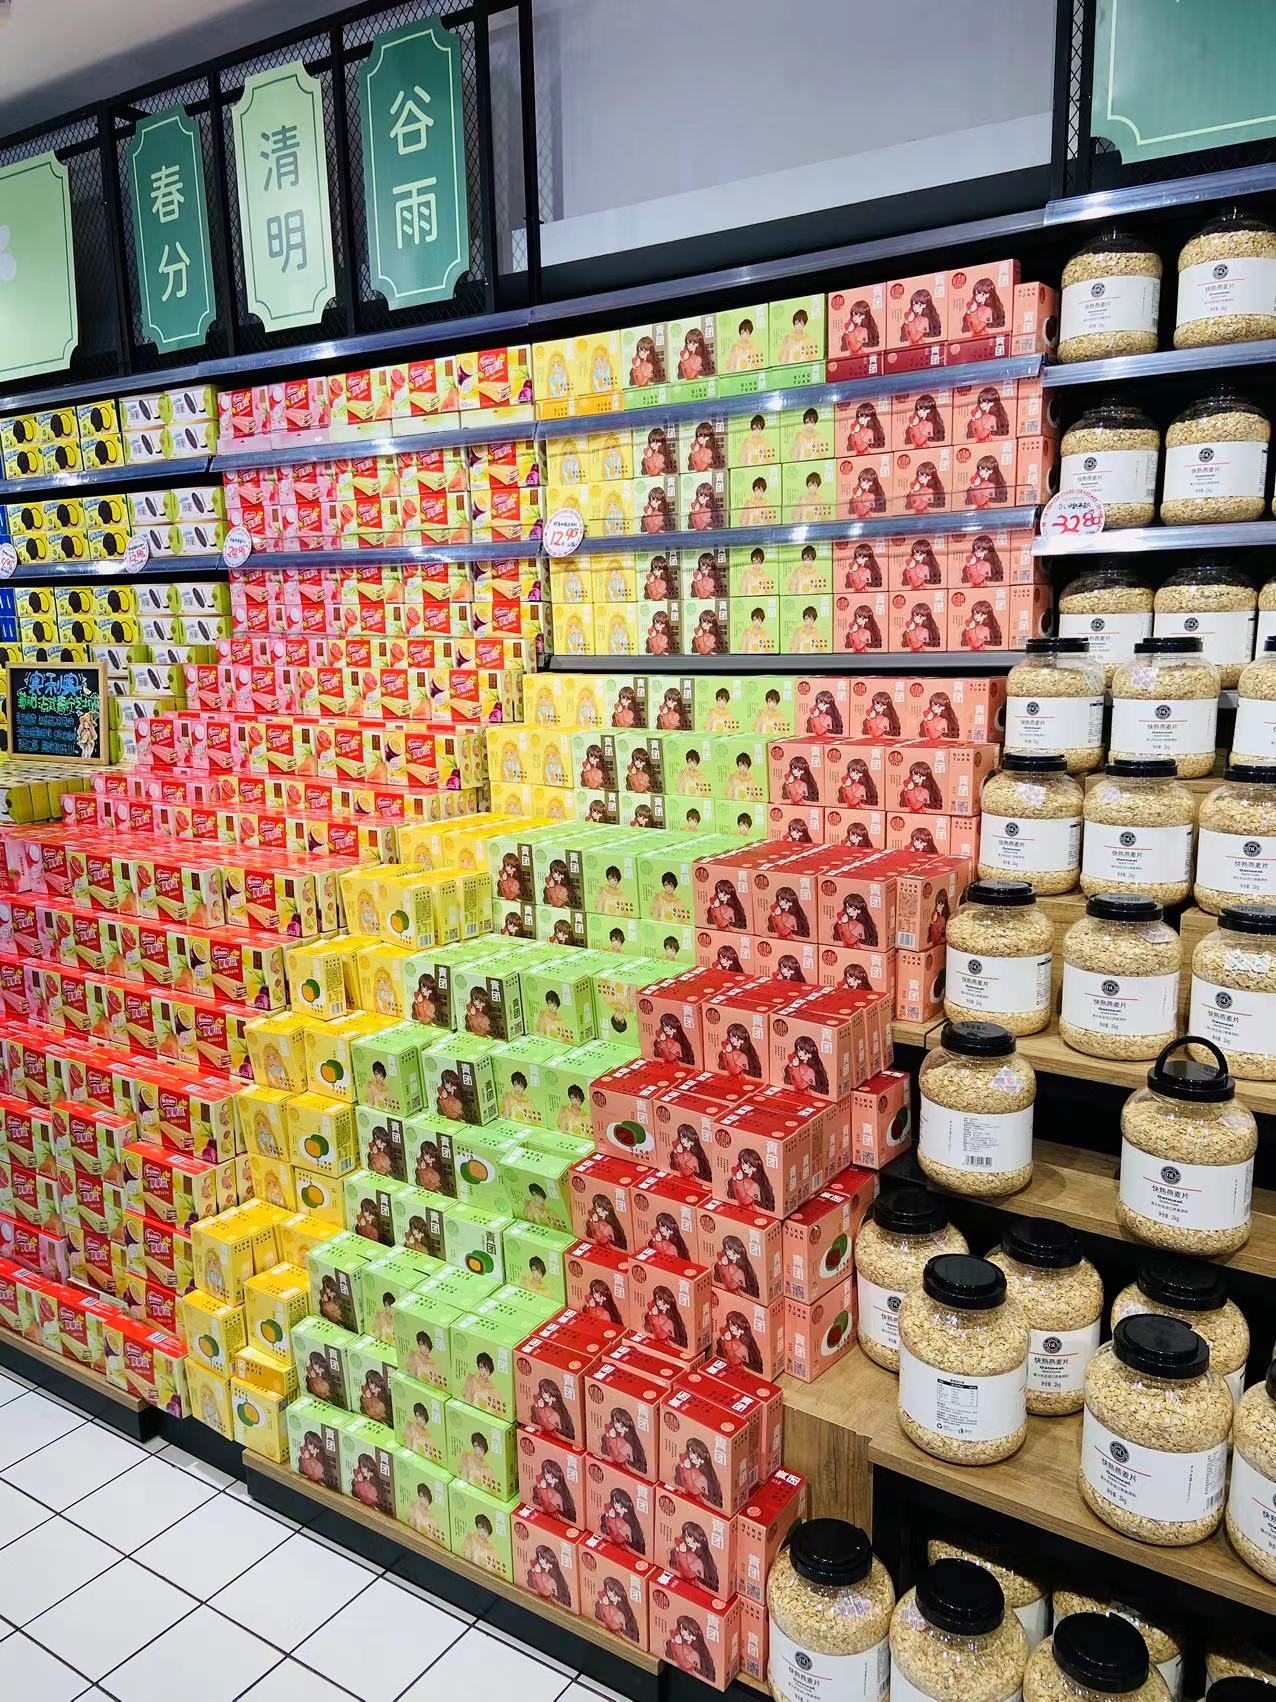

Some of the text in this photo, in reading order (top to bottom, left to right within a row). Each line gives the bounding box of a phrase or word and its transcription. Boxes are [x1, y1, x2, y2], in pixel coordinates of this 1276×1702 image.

[150, 165, 192, 304] 春分
[260, 125, 308, 274] 清明
[389, 84, 438, 250] 谷雨
